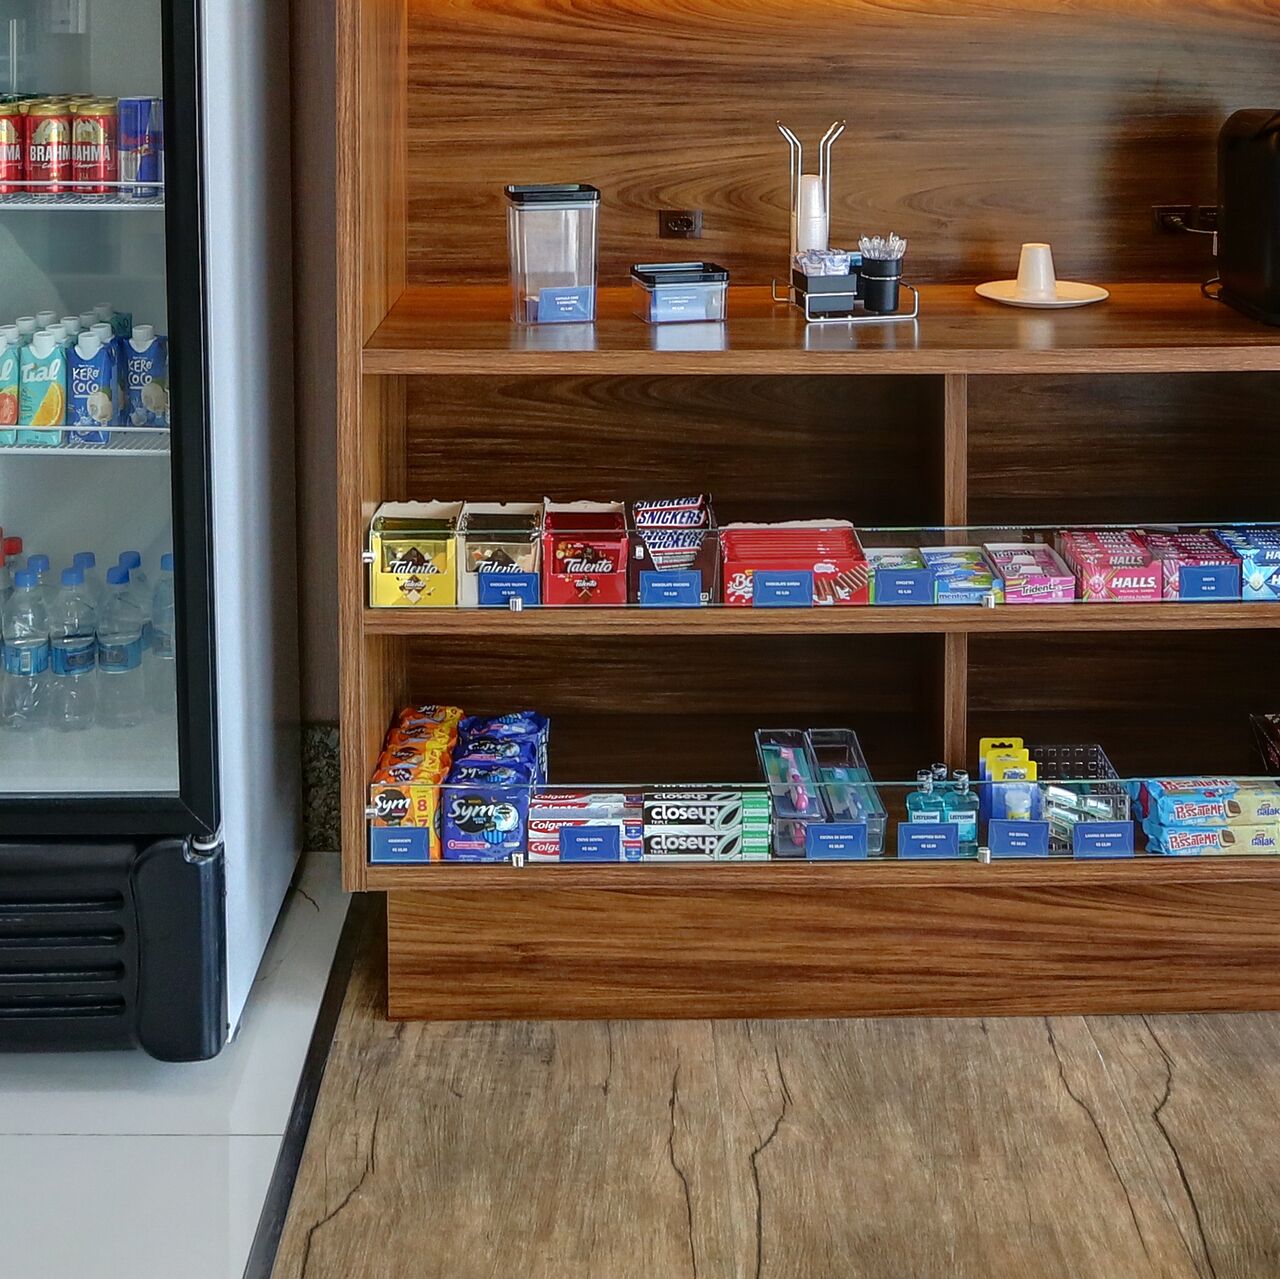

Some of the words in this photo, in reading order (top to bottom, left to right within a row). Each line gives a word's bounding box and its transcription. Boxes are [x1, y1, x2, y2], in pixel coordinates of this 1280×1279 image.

[30, 145, 70, 161] BRAHM
[637, 510, 702, 525] SNICKERS
[389, 560, 438, 574] Talento
[563, 558, 613, 573] Talento
[1109, 555, 1144, 565] HALLS
[1020, 583, 1055, 596] Trident
[1111, 576, 1157, 588] HALLS
[373, 793, 412, 813] Sym
[654, 793, 708, 801] closeup
[417, 799, 427, 811] 8
[447, 799, 495, 823] Sym
[651, 805, 719, 825] closeup
[650, 835, 719, 855] closeup
